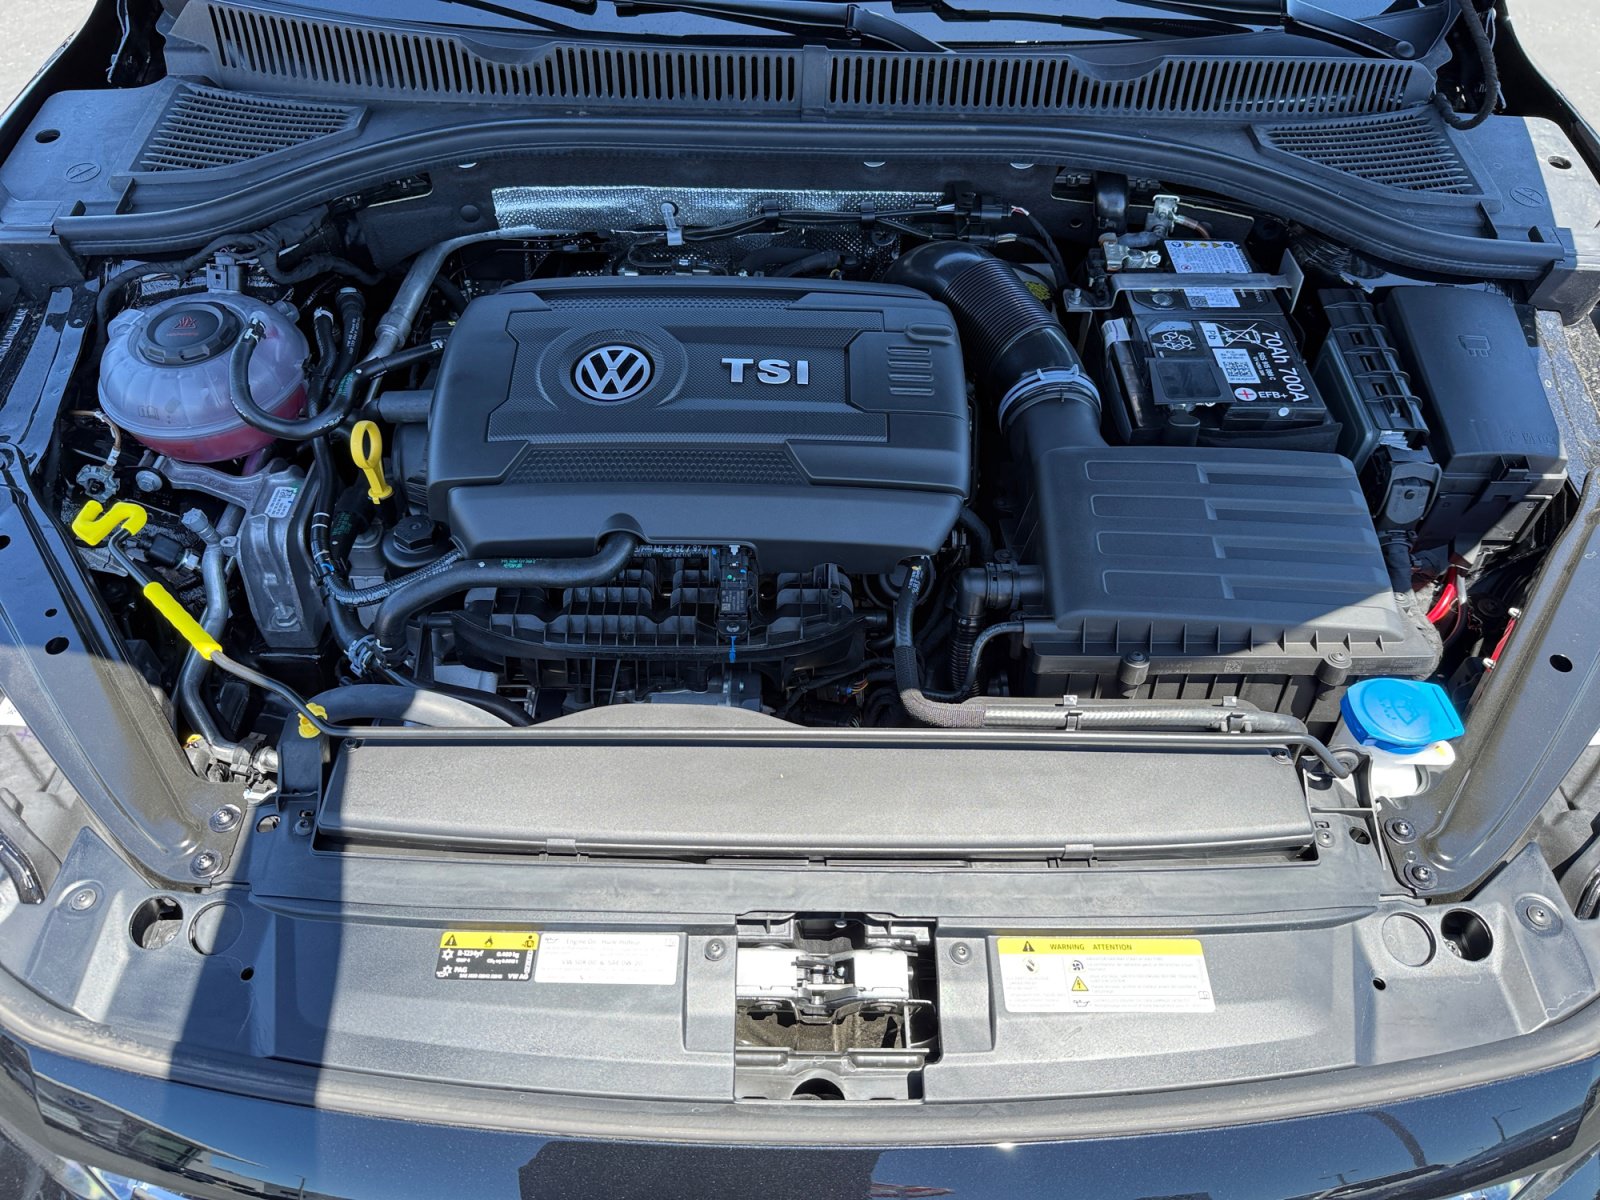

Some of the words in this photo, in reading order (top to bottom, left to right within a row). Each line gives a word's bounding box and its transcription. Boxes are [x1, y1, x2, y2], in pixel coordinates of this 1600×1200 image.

[721, 357, 809, 385] TSI
[1262, 332, 1290, 363] 70Ah
[1278, 368, 1309, 402] 700A
